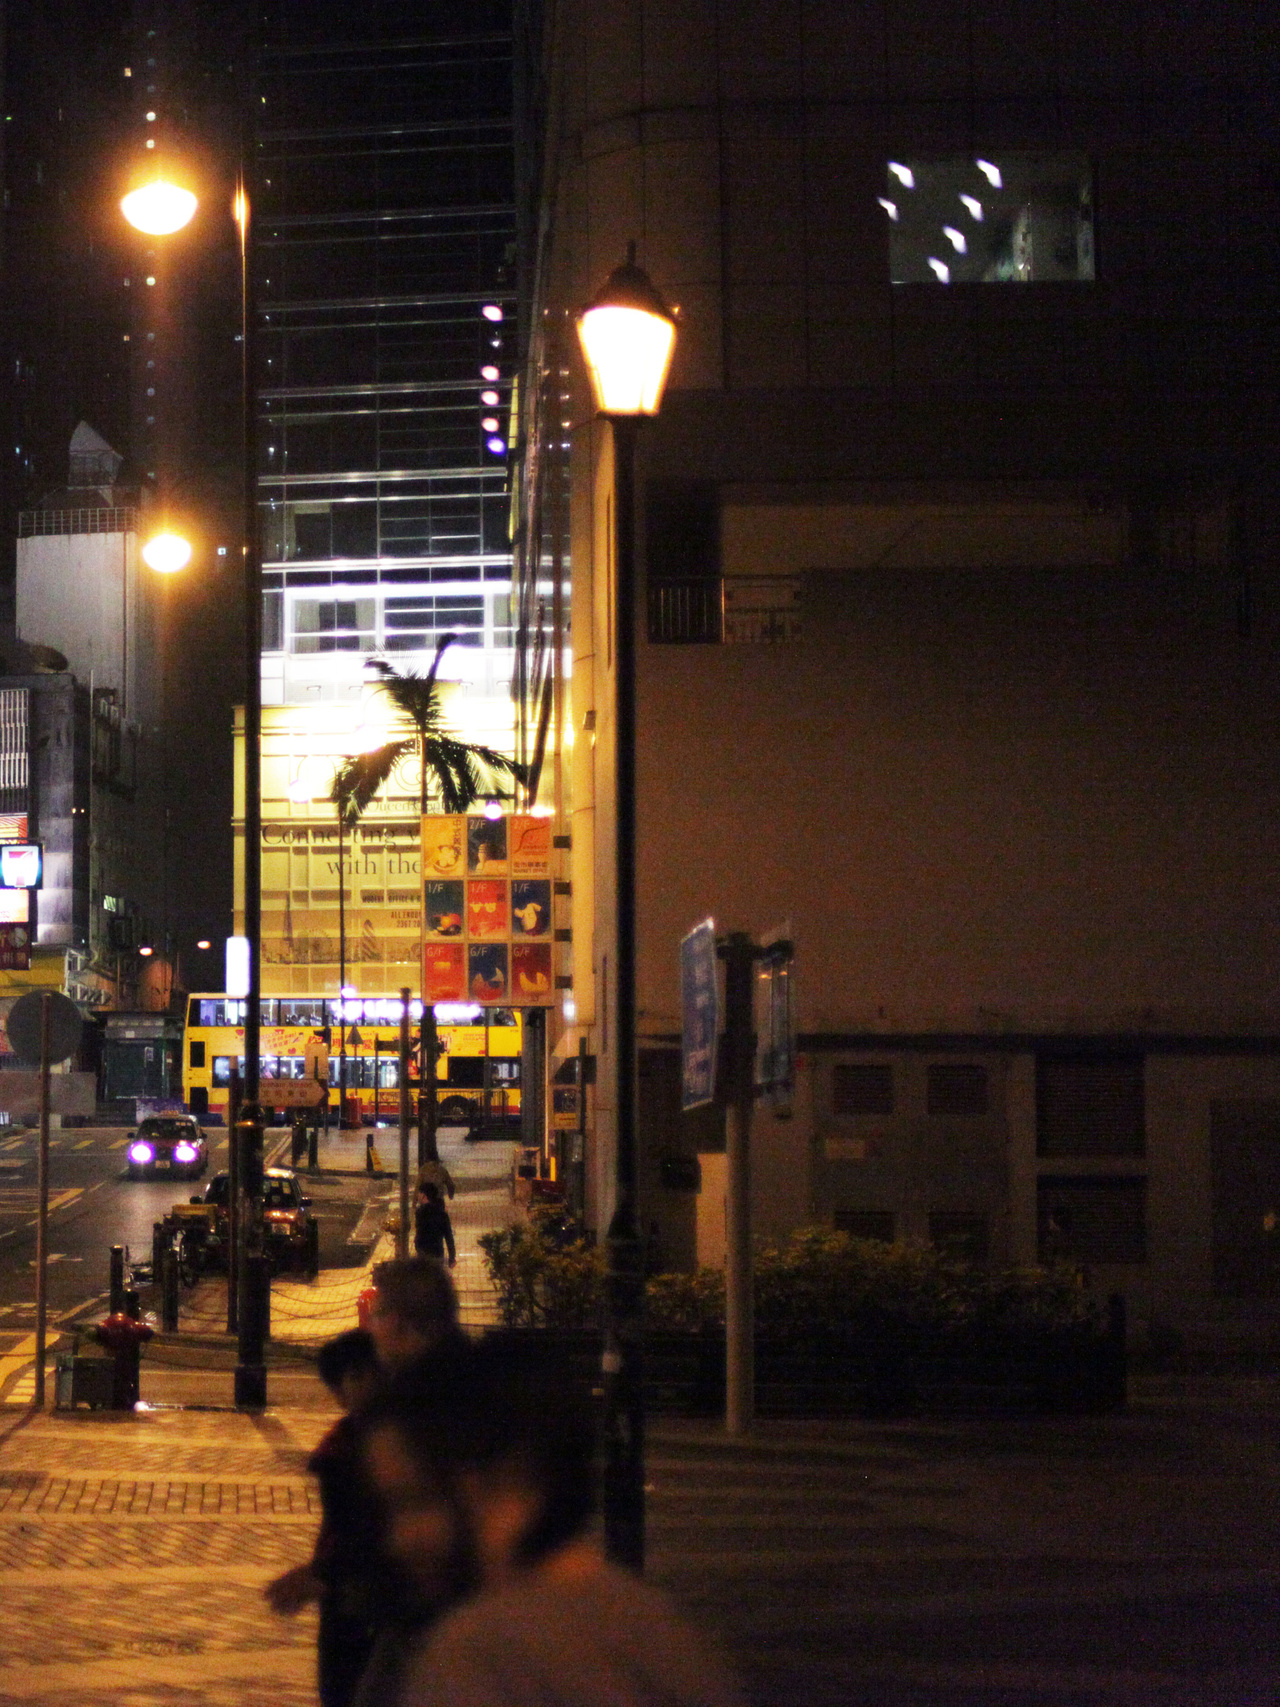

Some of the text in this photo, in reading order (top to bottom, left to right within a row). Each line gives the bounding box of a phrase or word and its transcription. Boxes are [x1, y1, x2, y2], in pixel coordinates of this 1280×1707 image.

[262, 823, 397, 851] Conneting
[327, 851, 421, 875] with the
[428, 883, 444, 893] 1/F
